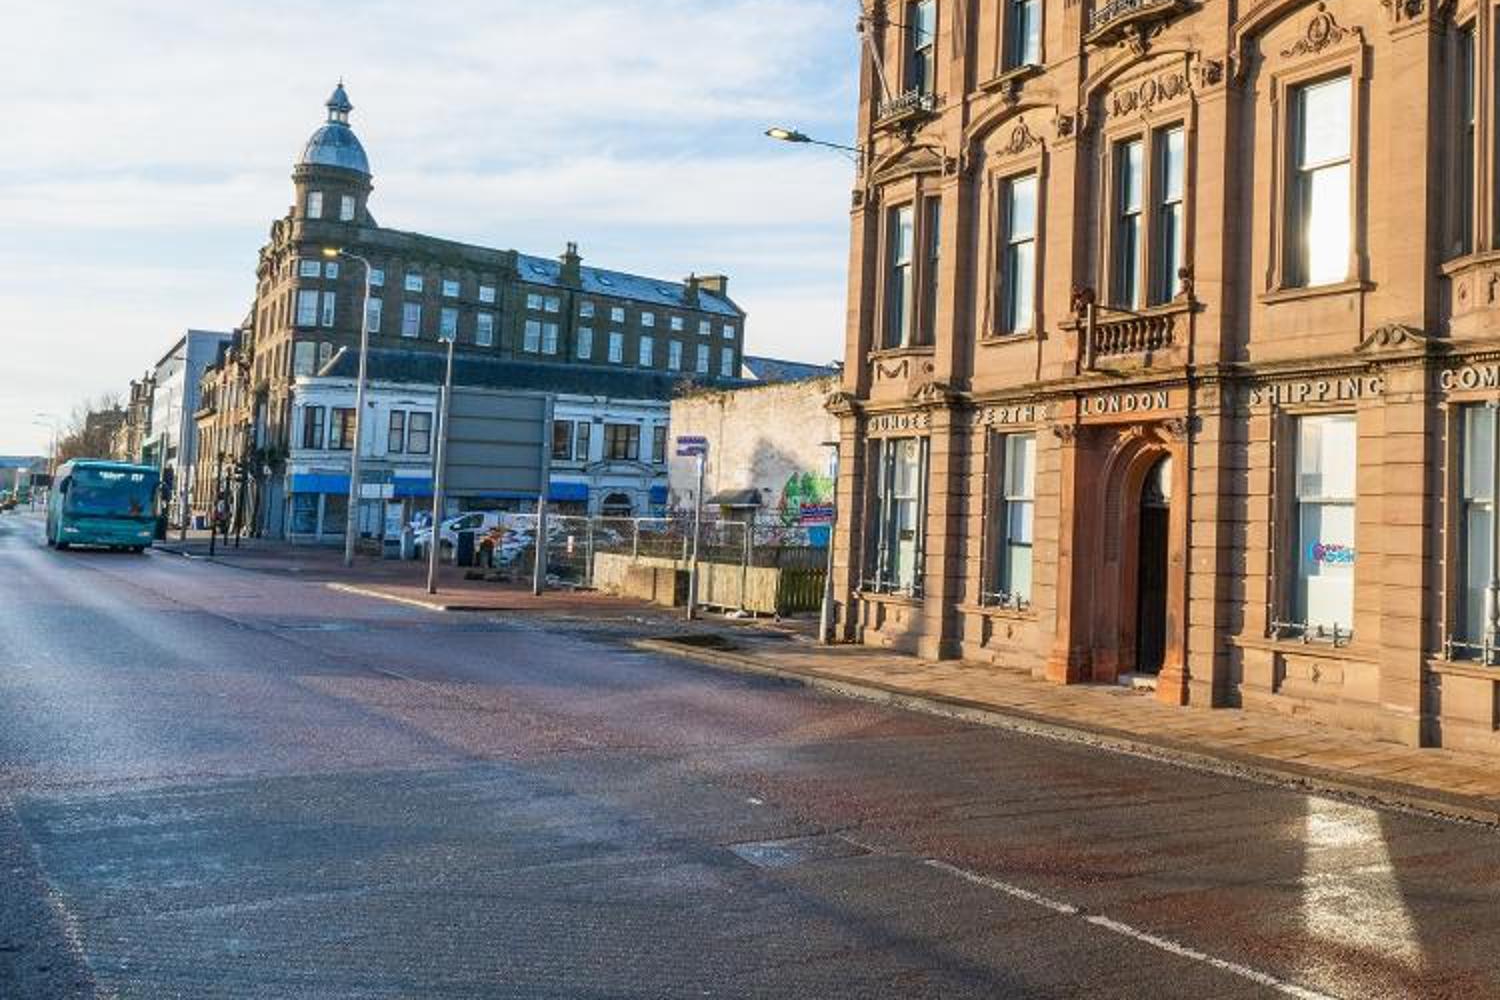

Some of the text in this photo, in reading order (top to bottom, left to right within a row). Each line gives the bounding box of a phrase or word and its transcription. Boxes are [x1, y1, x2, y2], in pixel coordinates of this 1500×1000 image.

[973, 405, 1035, 425] PERTH
[1079, 390, 1169, 417] LONDON
[1249, 376, 1385, 407] SHIPPING
